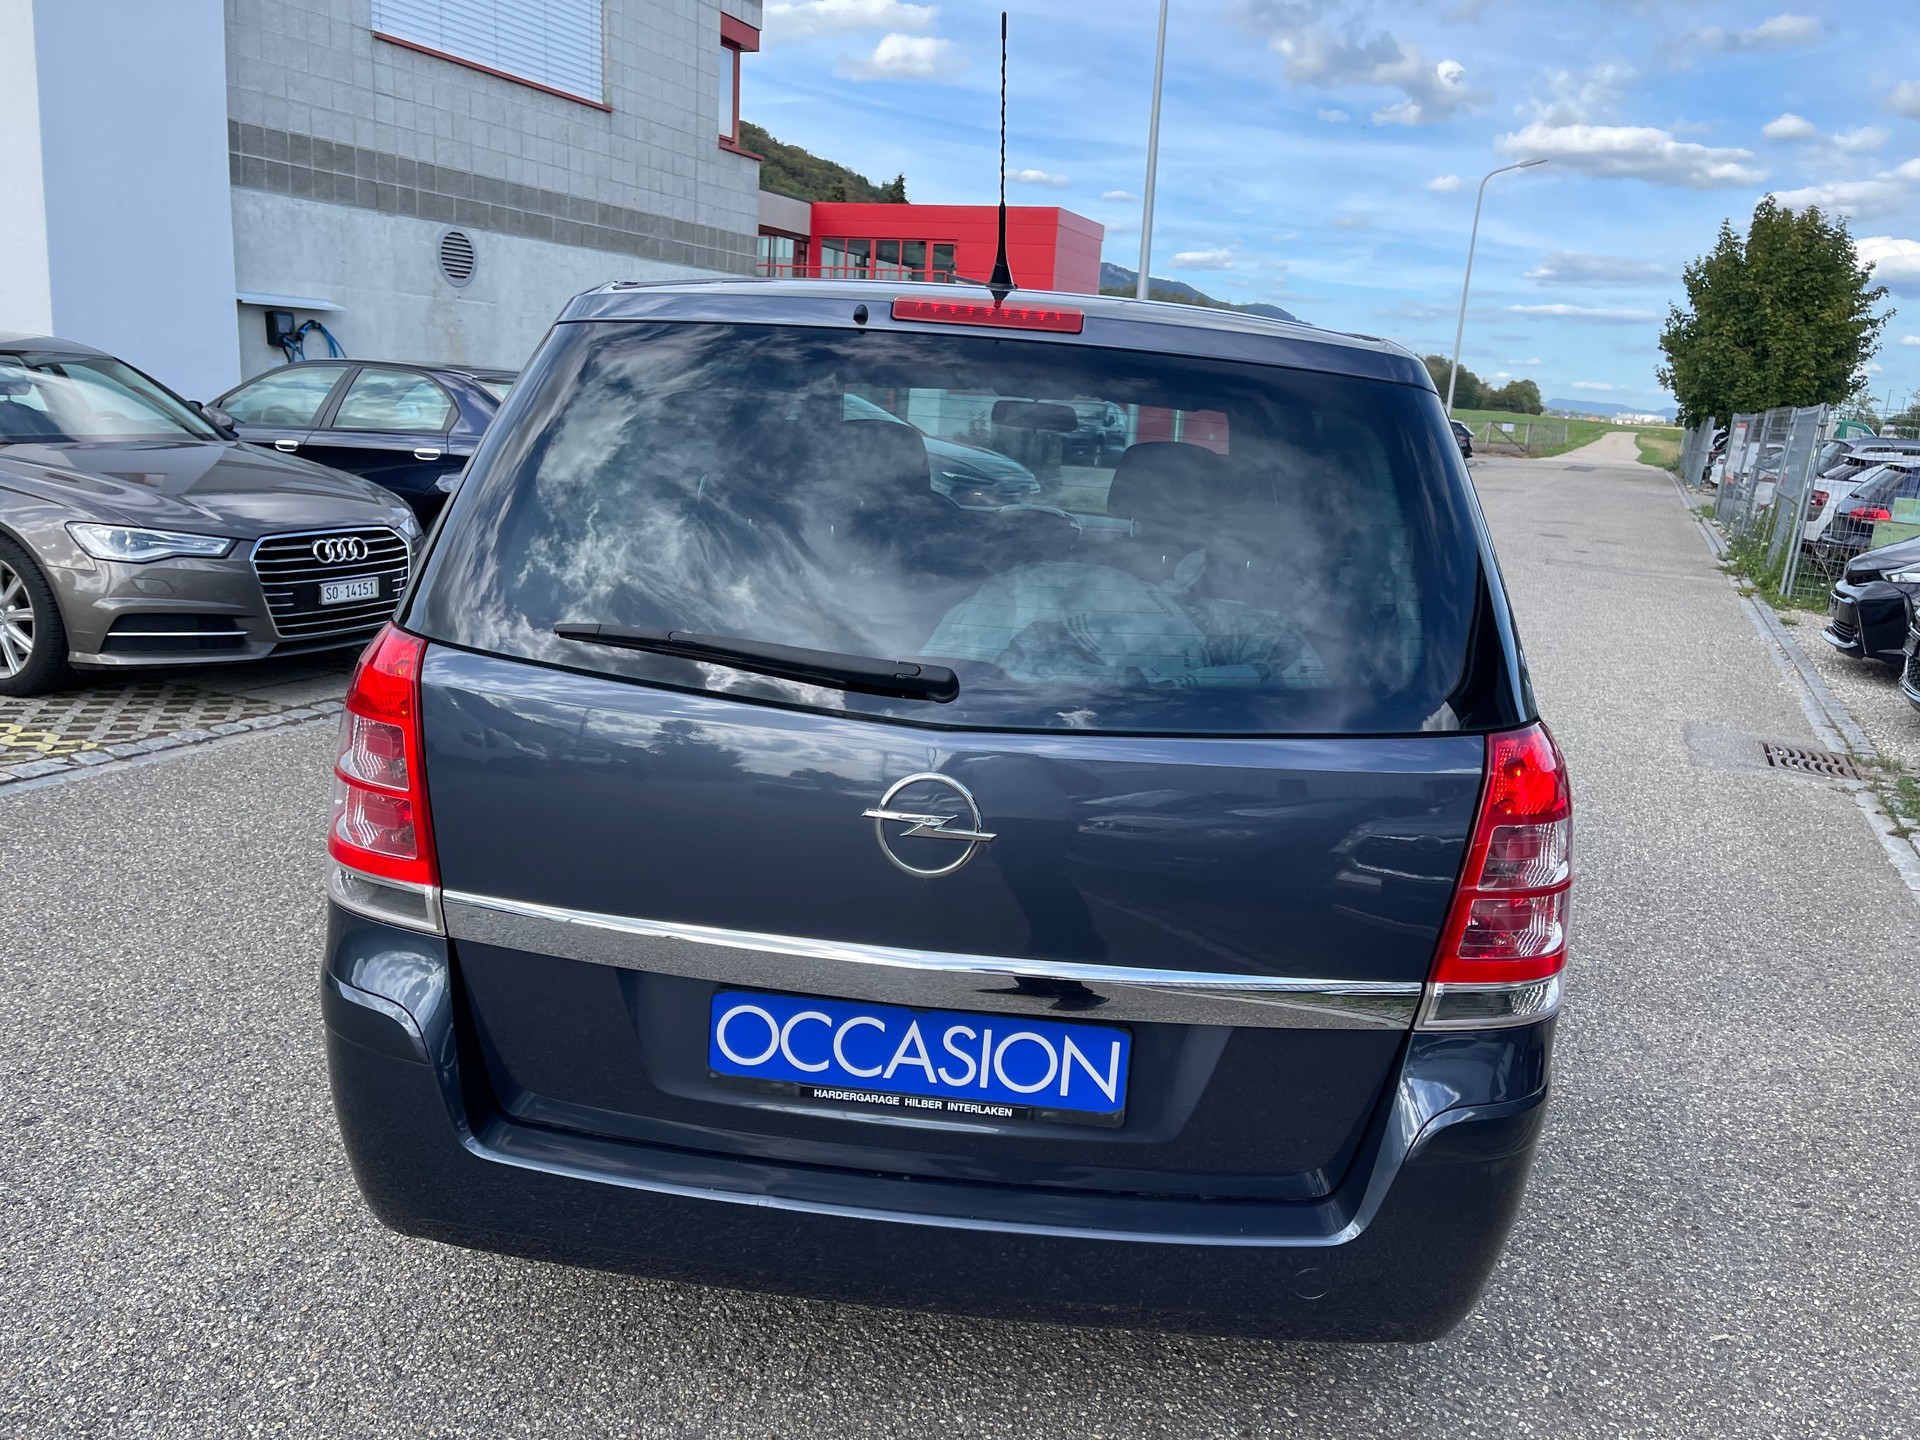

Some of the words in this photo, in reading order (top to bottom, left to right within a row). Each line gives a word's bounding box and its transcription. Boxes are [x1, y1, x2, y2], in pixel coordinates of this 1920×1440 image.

[715, 1004, 1121, 1104] OCCASION
[813, 1088, 900, 1106] HARDERGARAGE
[904, 1097, 943, 1110] HILBER
[946, 1101, 1013, 1117] INTERLAKEN
